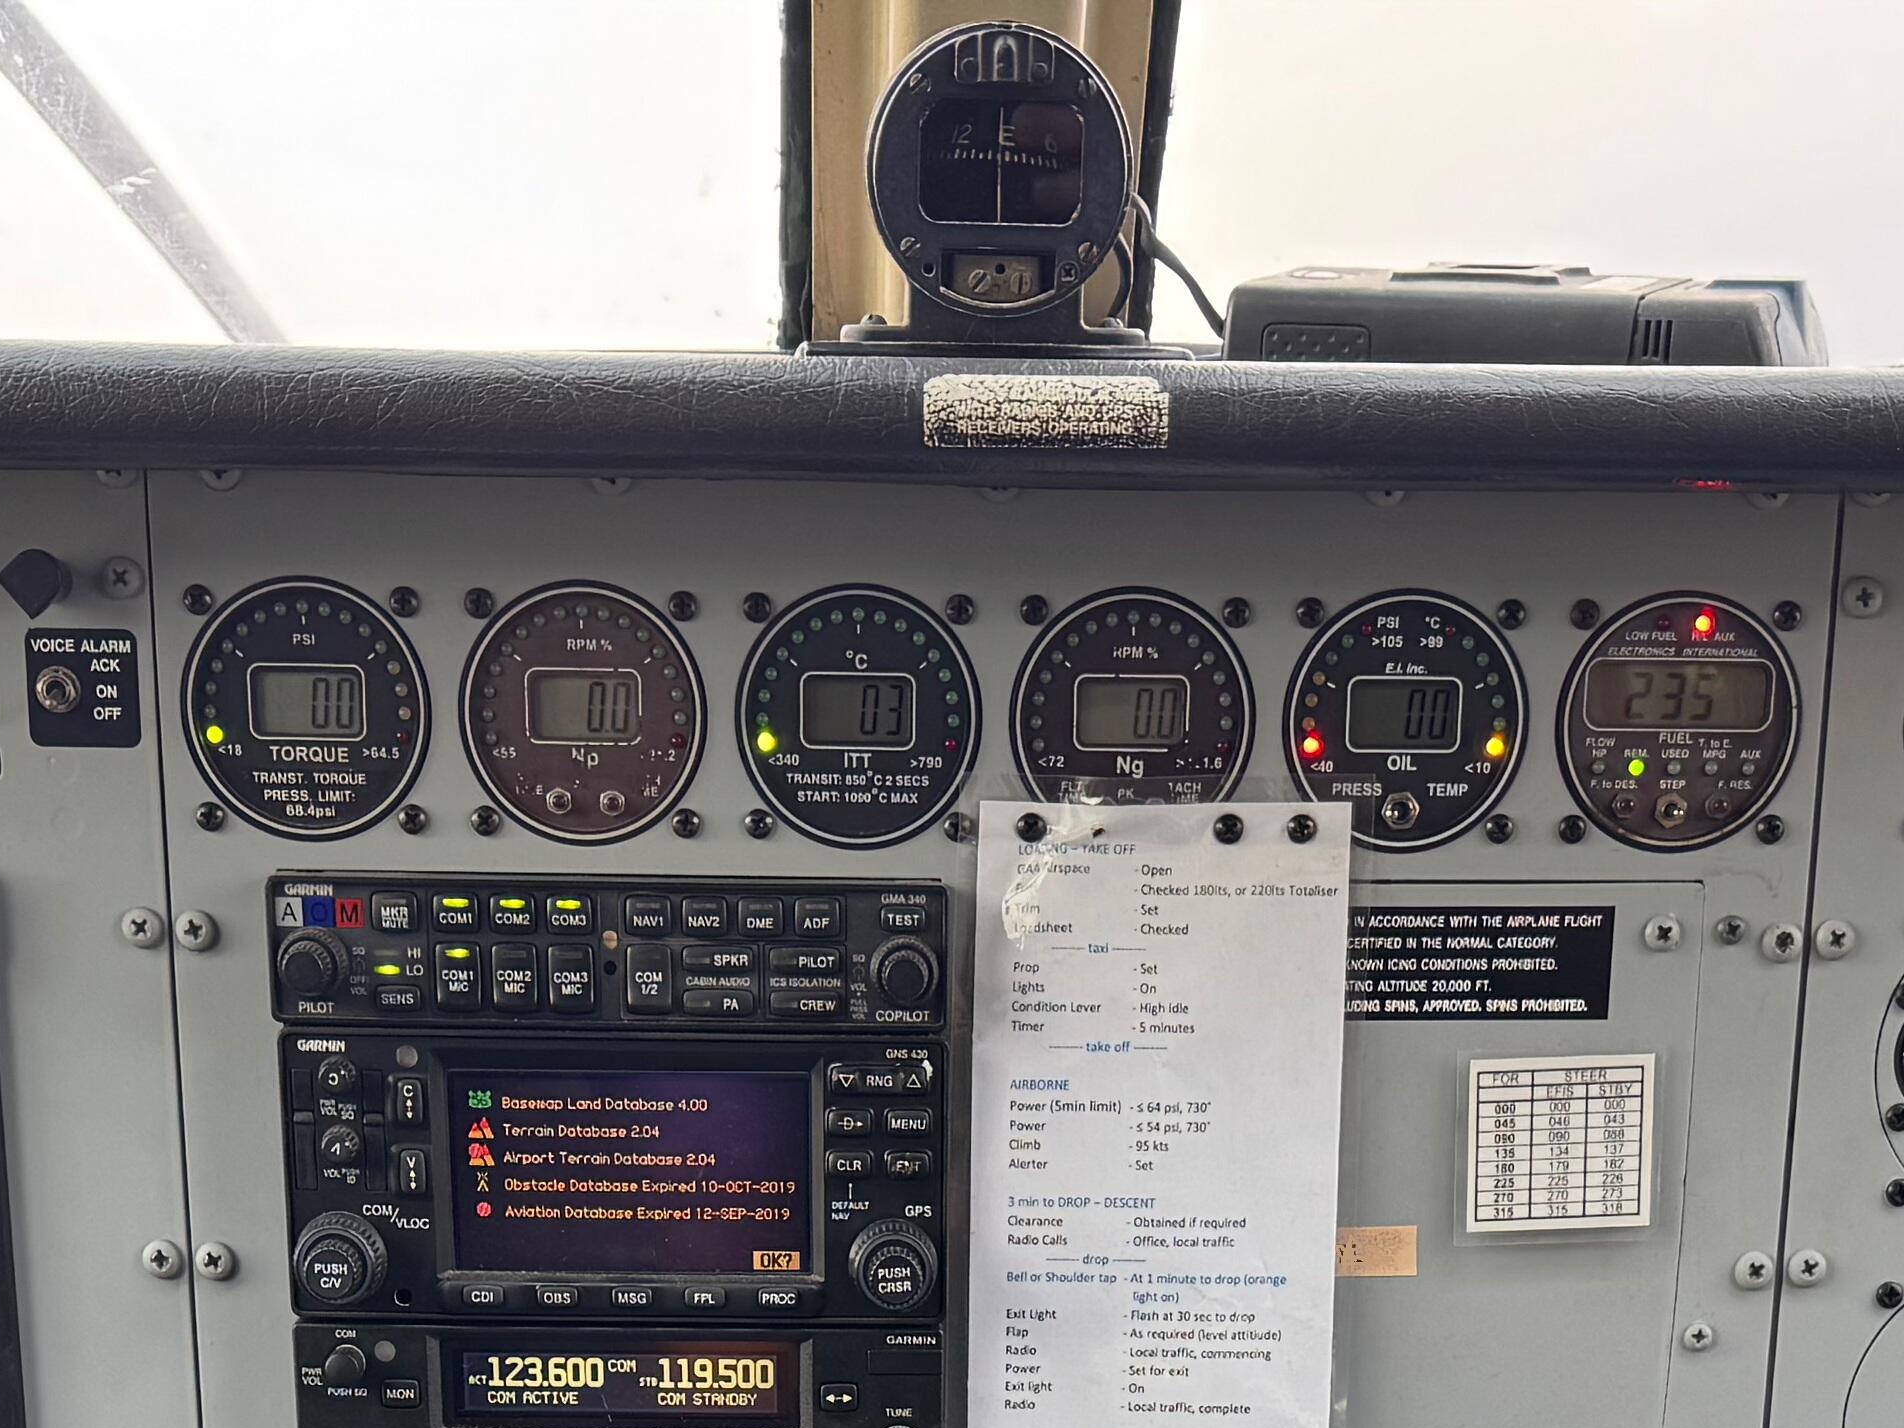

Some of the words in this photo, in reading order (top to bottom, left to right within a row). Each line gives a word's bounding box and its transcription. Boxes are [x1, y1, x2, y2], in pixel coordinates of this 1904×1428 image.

[30, 639, 74, 653] VOICE
[81, 639, 131, 654] ALARM
[269, 746, 350, 763] TORQUE
[844, 752, 871, 770] ITT
[1387, 756, 1416, 772] OIL
[888, 915, 919, 926] TEST
[713, 954, 748, 968] SPKR
[875, 1010, 930, 1023] COPILOT
[1010, 1079, 1070, 1090] AIRBORNE
[502, 1124, 555, 1140] Terrain
[560, 1124, 625, 1140] Database
[631, 1125, 659, 1140] 2.04
[1009, 1139, 1041, 1151] Climb
[760, 1253, 793, 1271] OK?
[488, 1358, 604, 1388] 123.600
[659, 1359, 774, 1389] 119.500
[488, 1391, 518, 1406] COM
[523, 1391, 578, 1406] ACTIVE
[658, 1392, 687, 1406] COM
[693, 1392, 757, 1407] STANDBY
